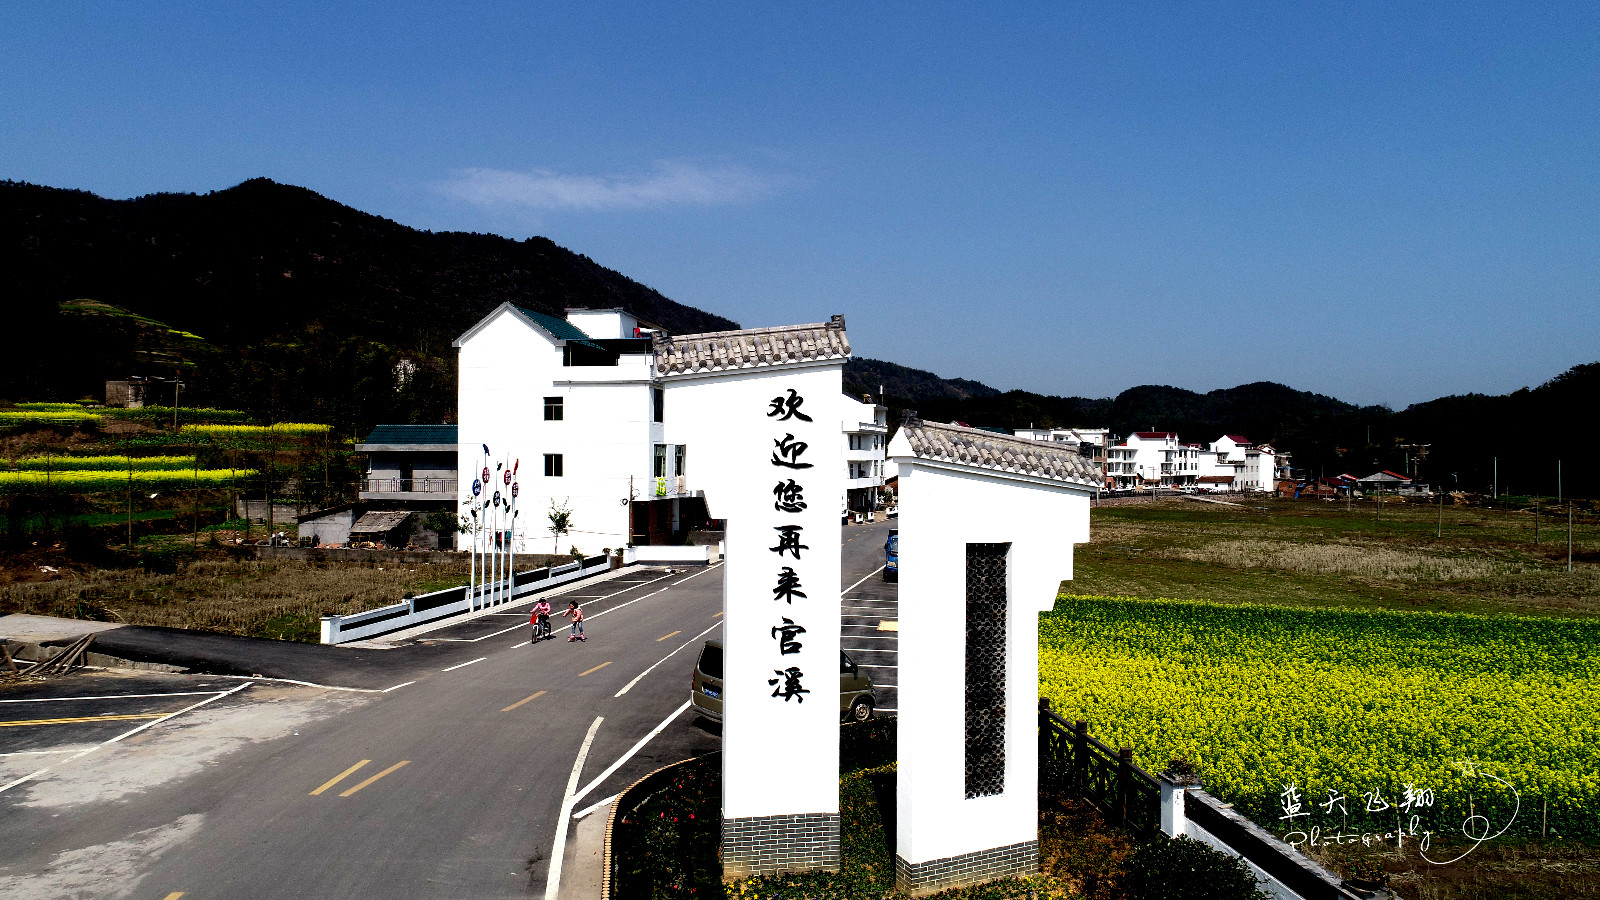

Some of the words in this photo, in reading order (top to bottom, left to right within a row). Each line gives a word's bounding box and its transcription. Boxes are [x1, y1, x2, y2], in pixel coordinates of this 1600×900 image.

[767, 388, 815, 704] 欢迎您再来官溪
